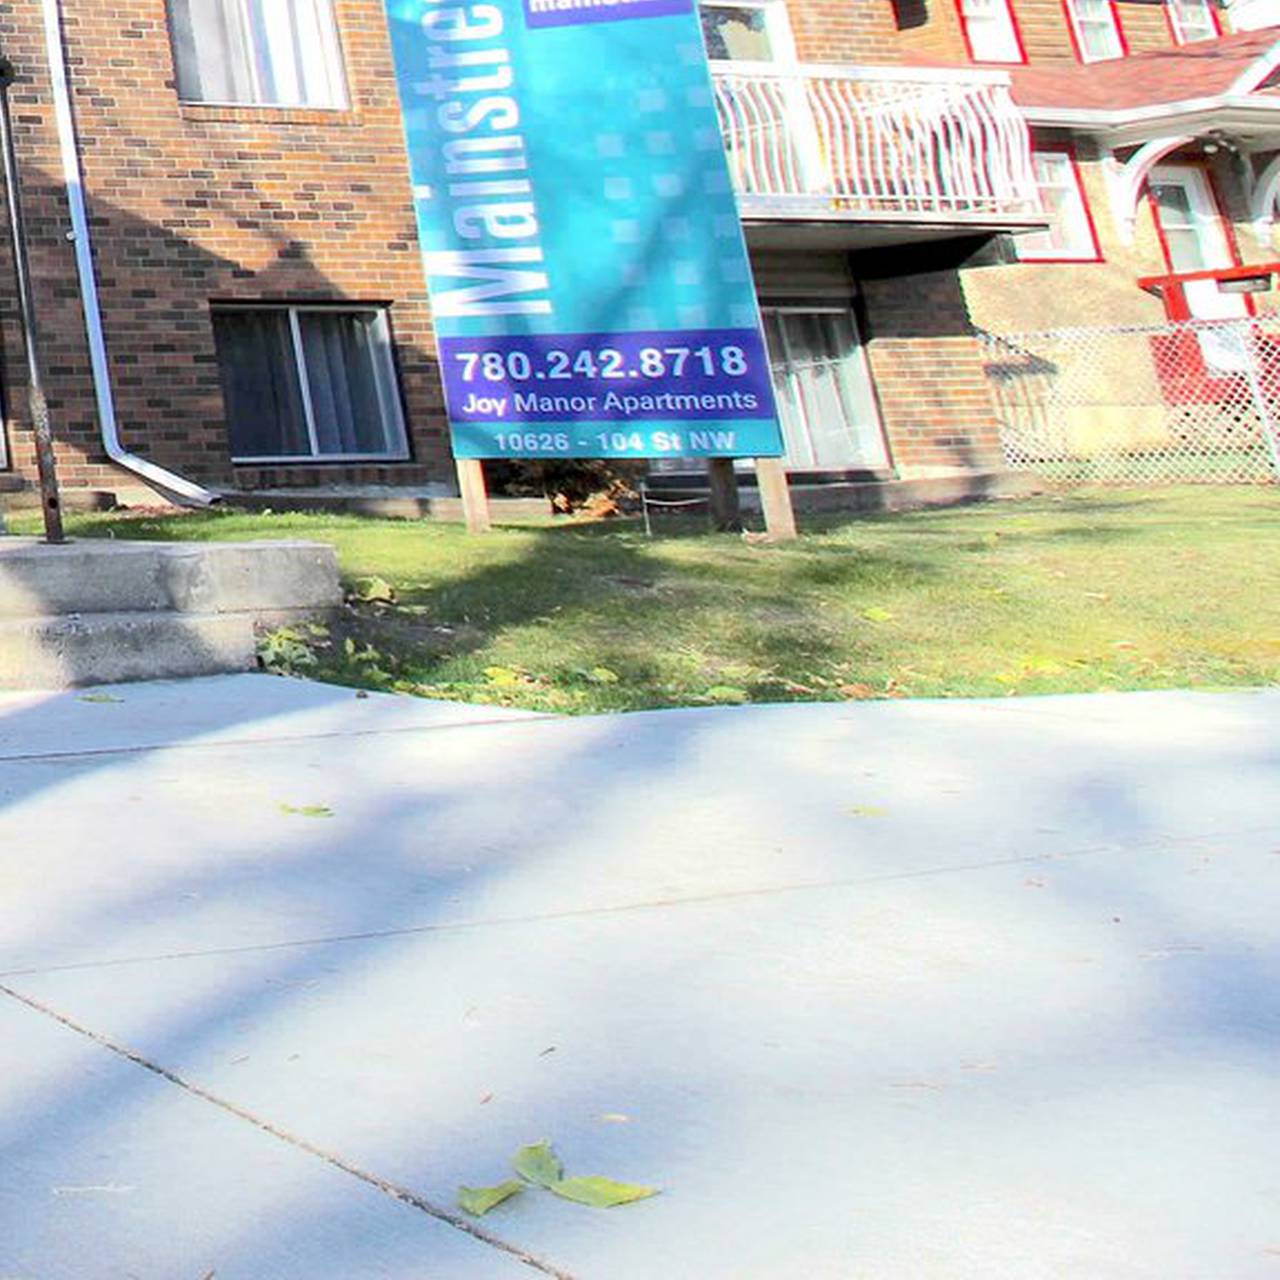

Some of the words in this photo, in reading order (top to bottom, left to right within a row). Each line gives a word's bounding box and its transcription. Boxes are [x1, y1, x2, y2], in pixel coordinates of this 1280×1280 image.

[455, 346, 747, 381] 780.242.8718
[462, 393, 507, 417] Joy
[514, 392, 596, 412] Manor
[603, 391, 758, 415] Apartments
[494, 433, 569, 451] 10626
[597, 432, 644, 451] 104
[652, 432, 681, 451] St
[691, 431, 735, 450] NW
